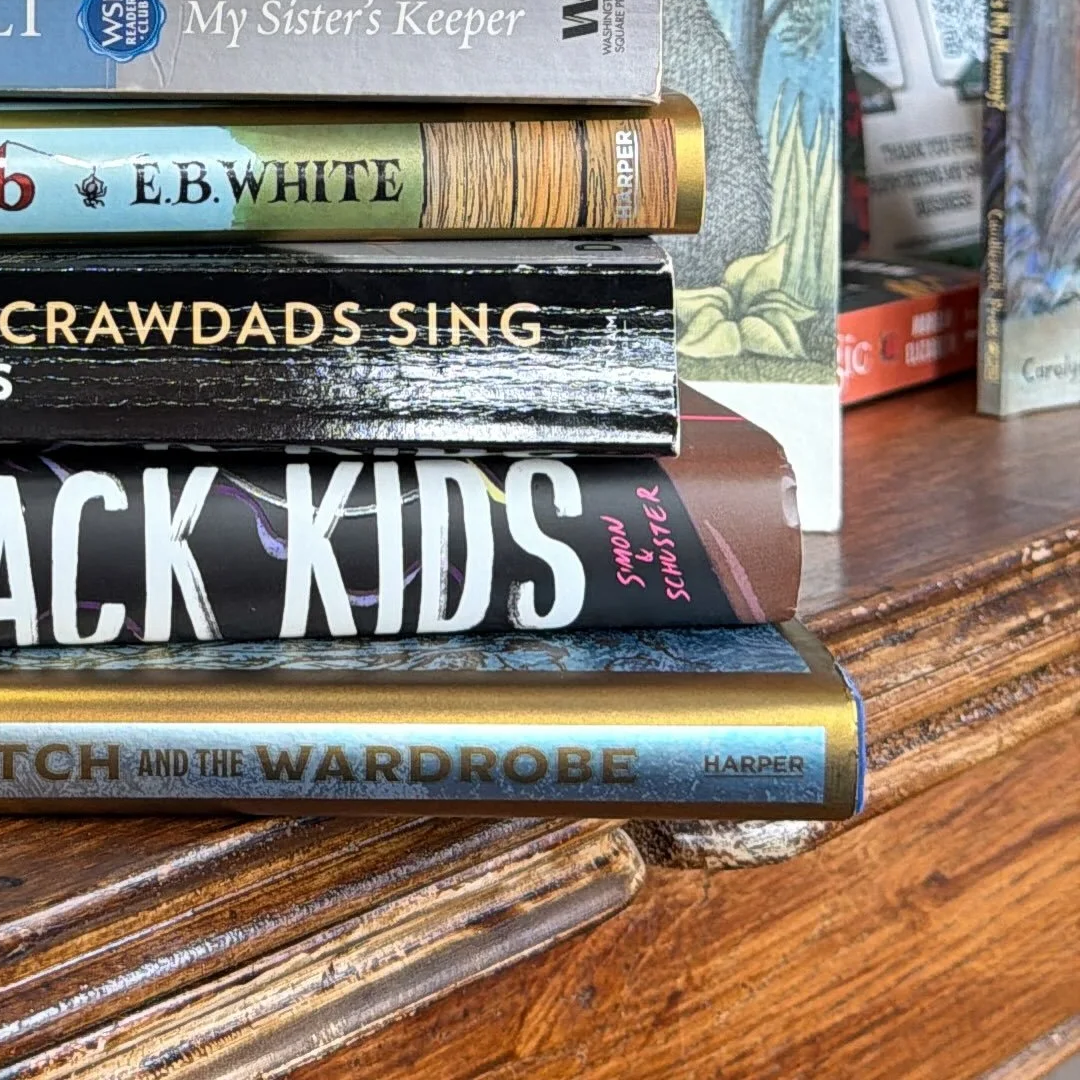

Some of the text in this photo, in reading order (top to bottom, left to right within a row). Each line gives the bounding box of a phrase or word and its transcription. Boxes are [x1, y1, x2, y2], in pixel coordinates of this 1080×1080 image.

[138, 0, 149, 34] CLUB
[183, 0, 246, 49] My
[394, 0, 526, 49] Keeper
[614, 11, 625, 53] SQUARE
[615, 130, 634, 219] HARPER
[0, 301, 361, 345] CRAWDADS
[388, 301, 543, 347] SING
[280, 458, 586, 638] KIDS
[600, 515, 646, 588] SIMON
[635, 548, 654, 562] &
[636, 485, 691, 602] SCHUSTER
[138, 749, 190, 778] AND
[196, 748, 244, 778] THE
[255, 743, 639, 785] WARDROBE
[703, 755, 805, 776] HARPER
